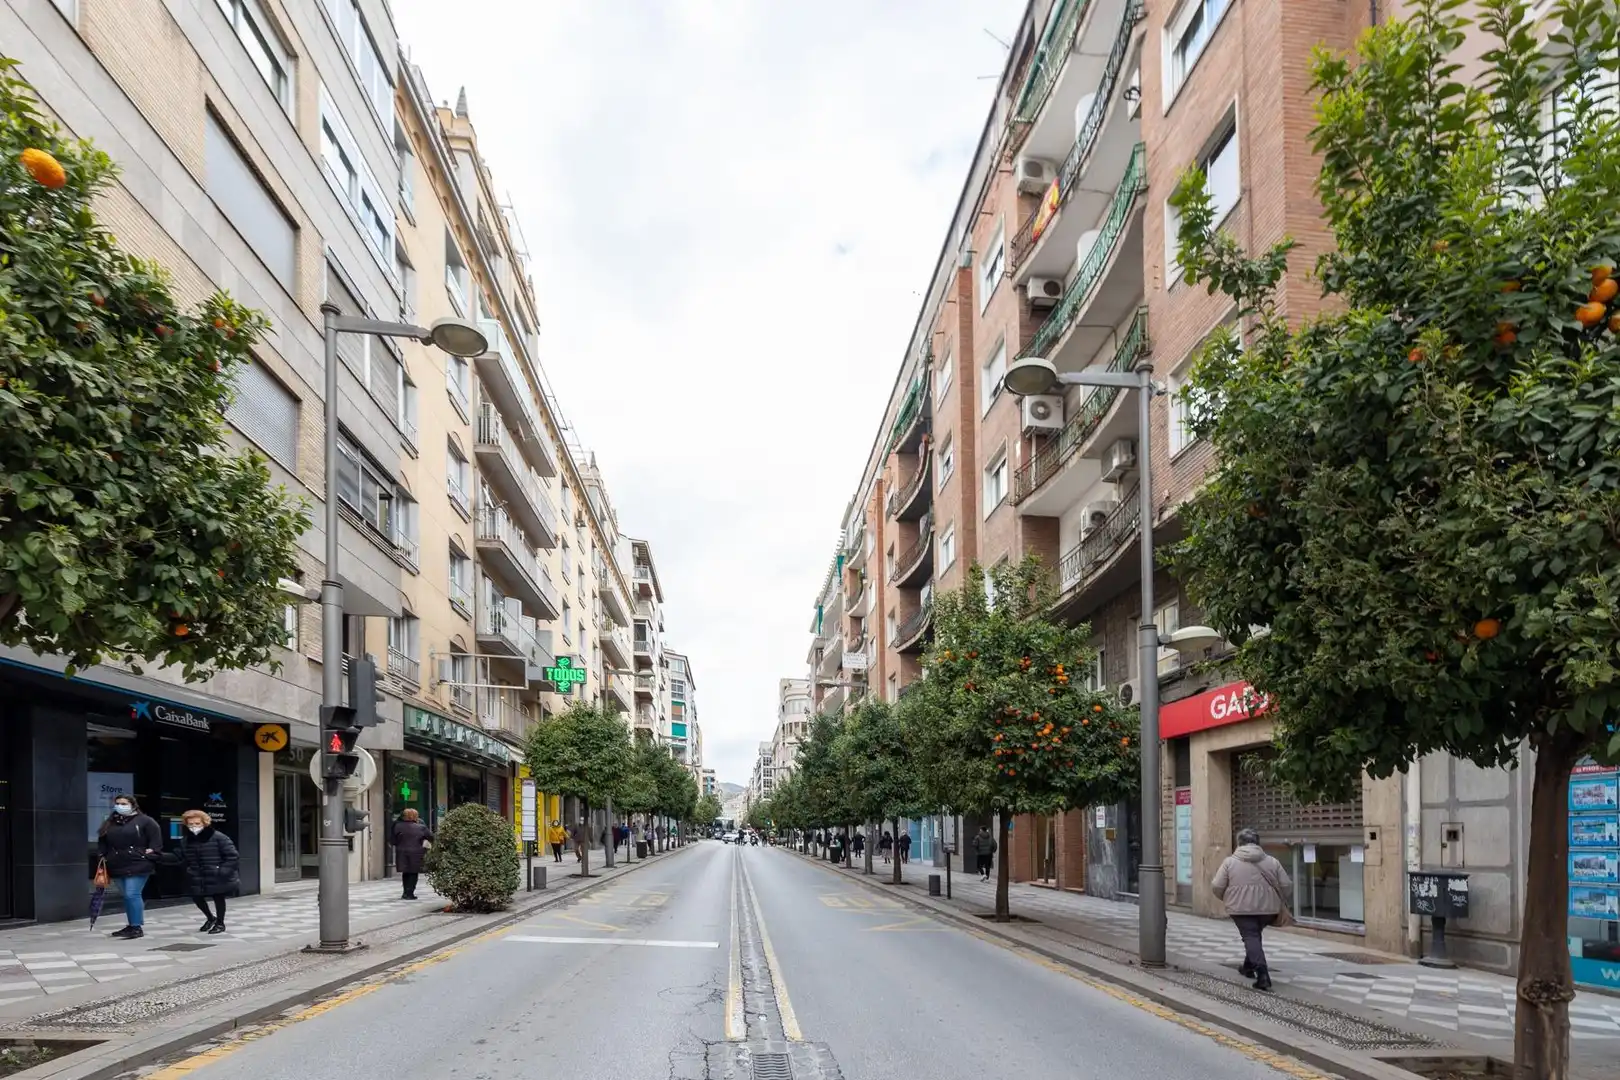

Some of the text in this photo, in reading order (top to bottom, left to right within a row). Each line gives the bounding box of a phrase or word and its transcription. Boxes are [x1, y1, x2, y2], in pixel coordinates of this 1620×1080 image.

[546, 668, 585, 681] TODOS
[154, 705, 210, 730] CaixaBank
[101, 784, 123, 793] Store
